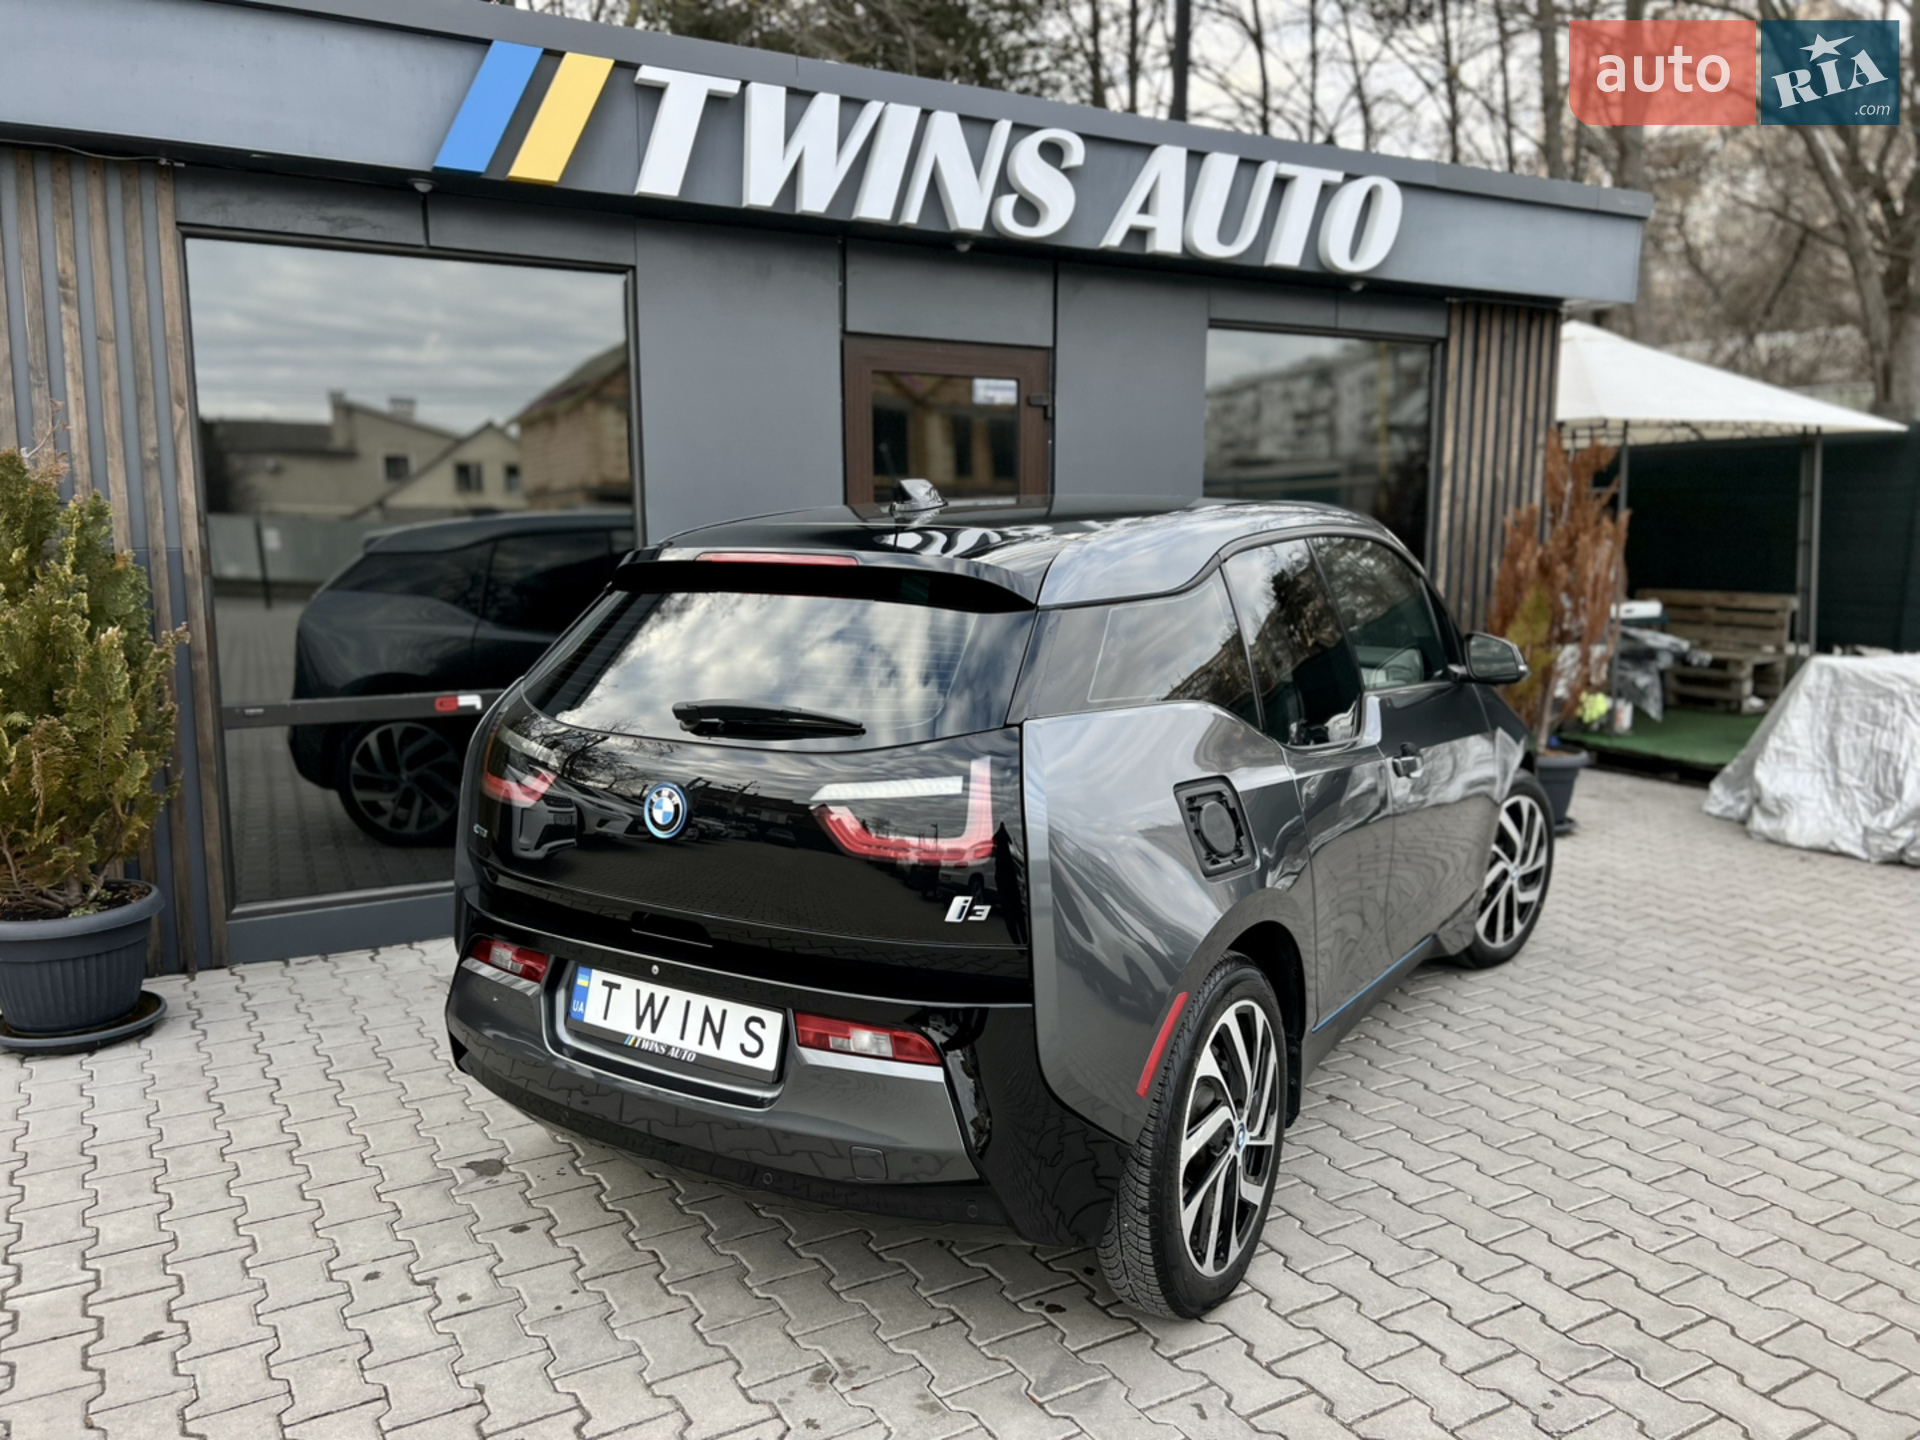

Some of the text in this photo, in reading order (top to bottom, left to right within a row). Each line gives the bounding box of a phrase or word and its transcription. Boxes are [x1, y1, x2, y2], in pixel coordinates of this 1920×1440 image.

[634, 64, 1403, 274] TWINS AUTO
[944, 896, 992, 923] i3
[571, 999, 585, 1014] UA
[601, 979, 767, 1058] TWINS
[634, 1037, 697, 1062] TWINS AUTO
